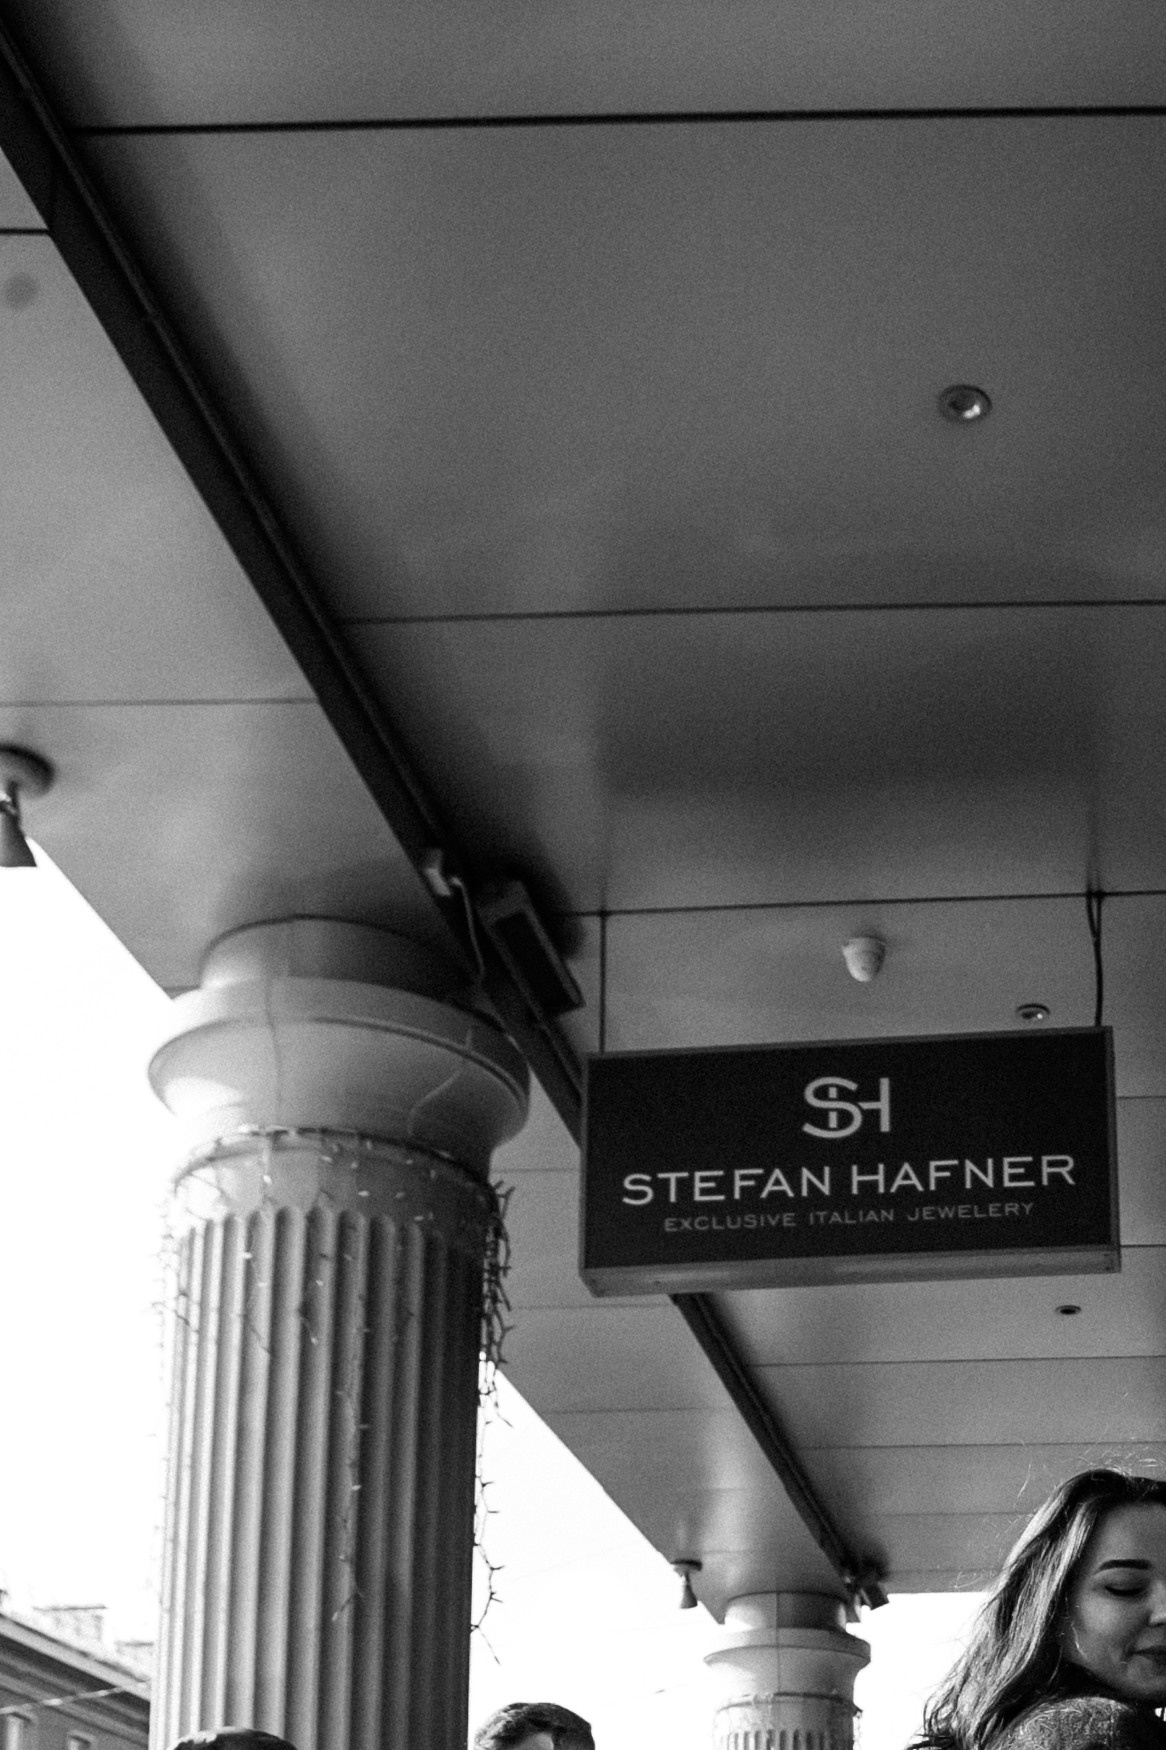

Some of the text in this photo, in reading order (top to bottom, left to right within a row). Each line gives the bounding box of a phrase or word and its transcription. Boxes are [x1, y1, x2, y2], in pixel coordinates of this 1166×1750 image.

[621, 1154, 1077, 1206] STEFAN HAFNER
[663, 1200, 1036, 1232] EXCLUSIVE ITALIAN JEWELERY
